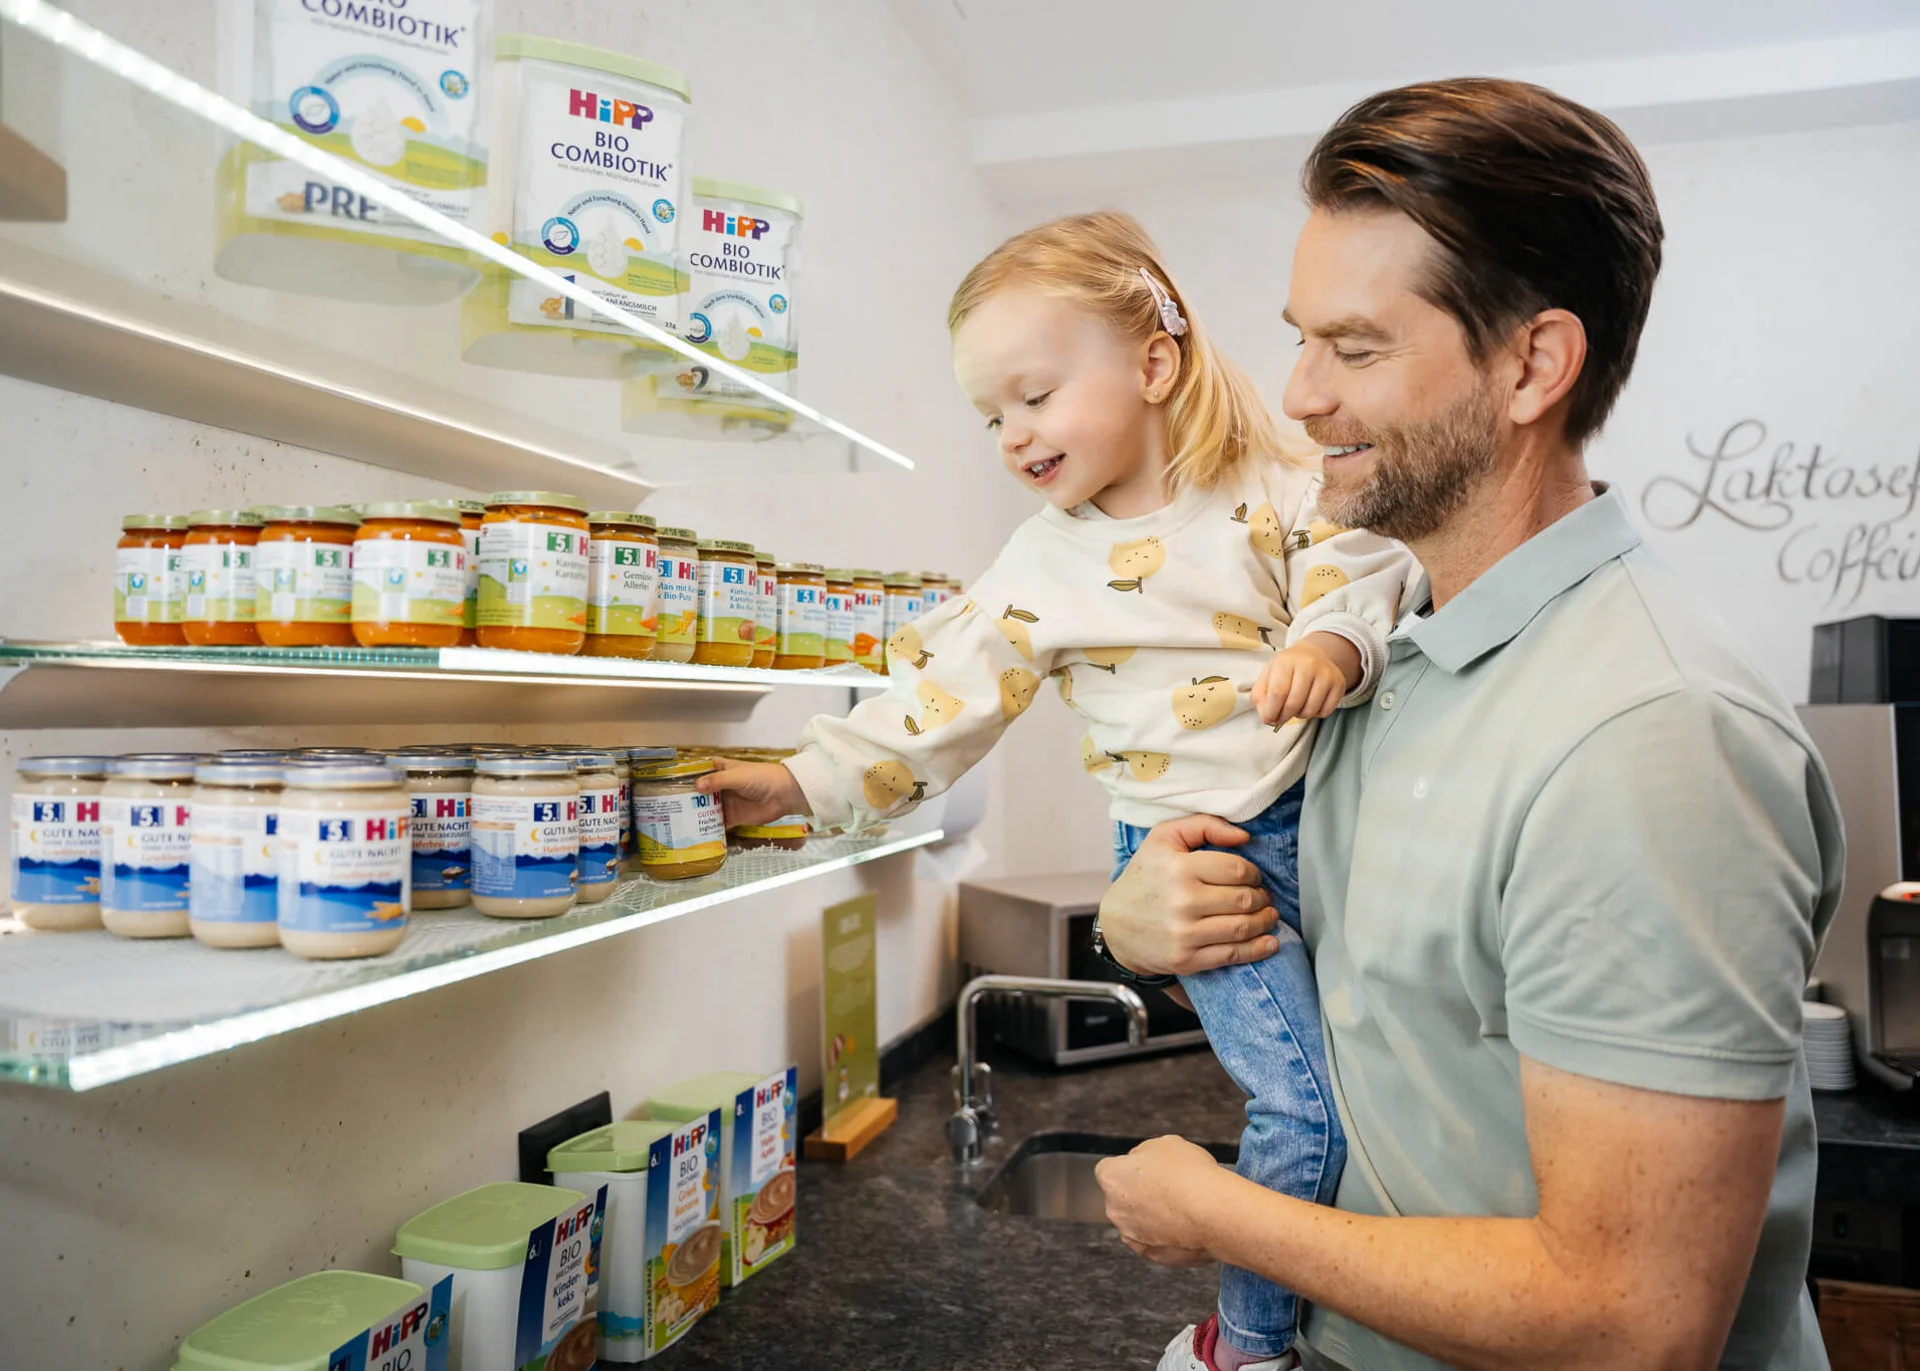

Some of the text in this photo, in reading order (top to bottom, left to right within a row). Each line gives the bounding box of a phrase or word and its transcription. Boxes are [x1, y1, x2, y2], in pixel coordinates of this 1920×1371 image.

[569, 88, 654, 131] HiPP
[595, 131, 629, 152] BIO
[702, 209, 770, 240] HiPP
[723, 242, 750, 259] BIO
[438, 821, 470, 833] NACHT
[543, 827, 566, 837] GUTE
[579, 818, 601, 828] GUTE
[42, 829, 74, 840] GUTE
[142, 834, 172, 844] GUTE
[673, 1123, 707, 1158] HiPP
[680, 1154, 699, 1178] BIO
[554, 1202, 595, 1247] HiPP
[560, 1239, 582, 1268] BIO
[371, 1302, 428, 1362] HiPP
